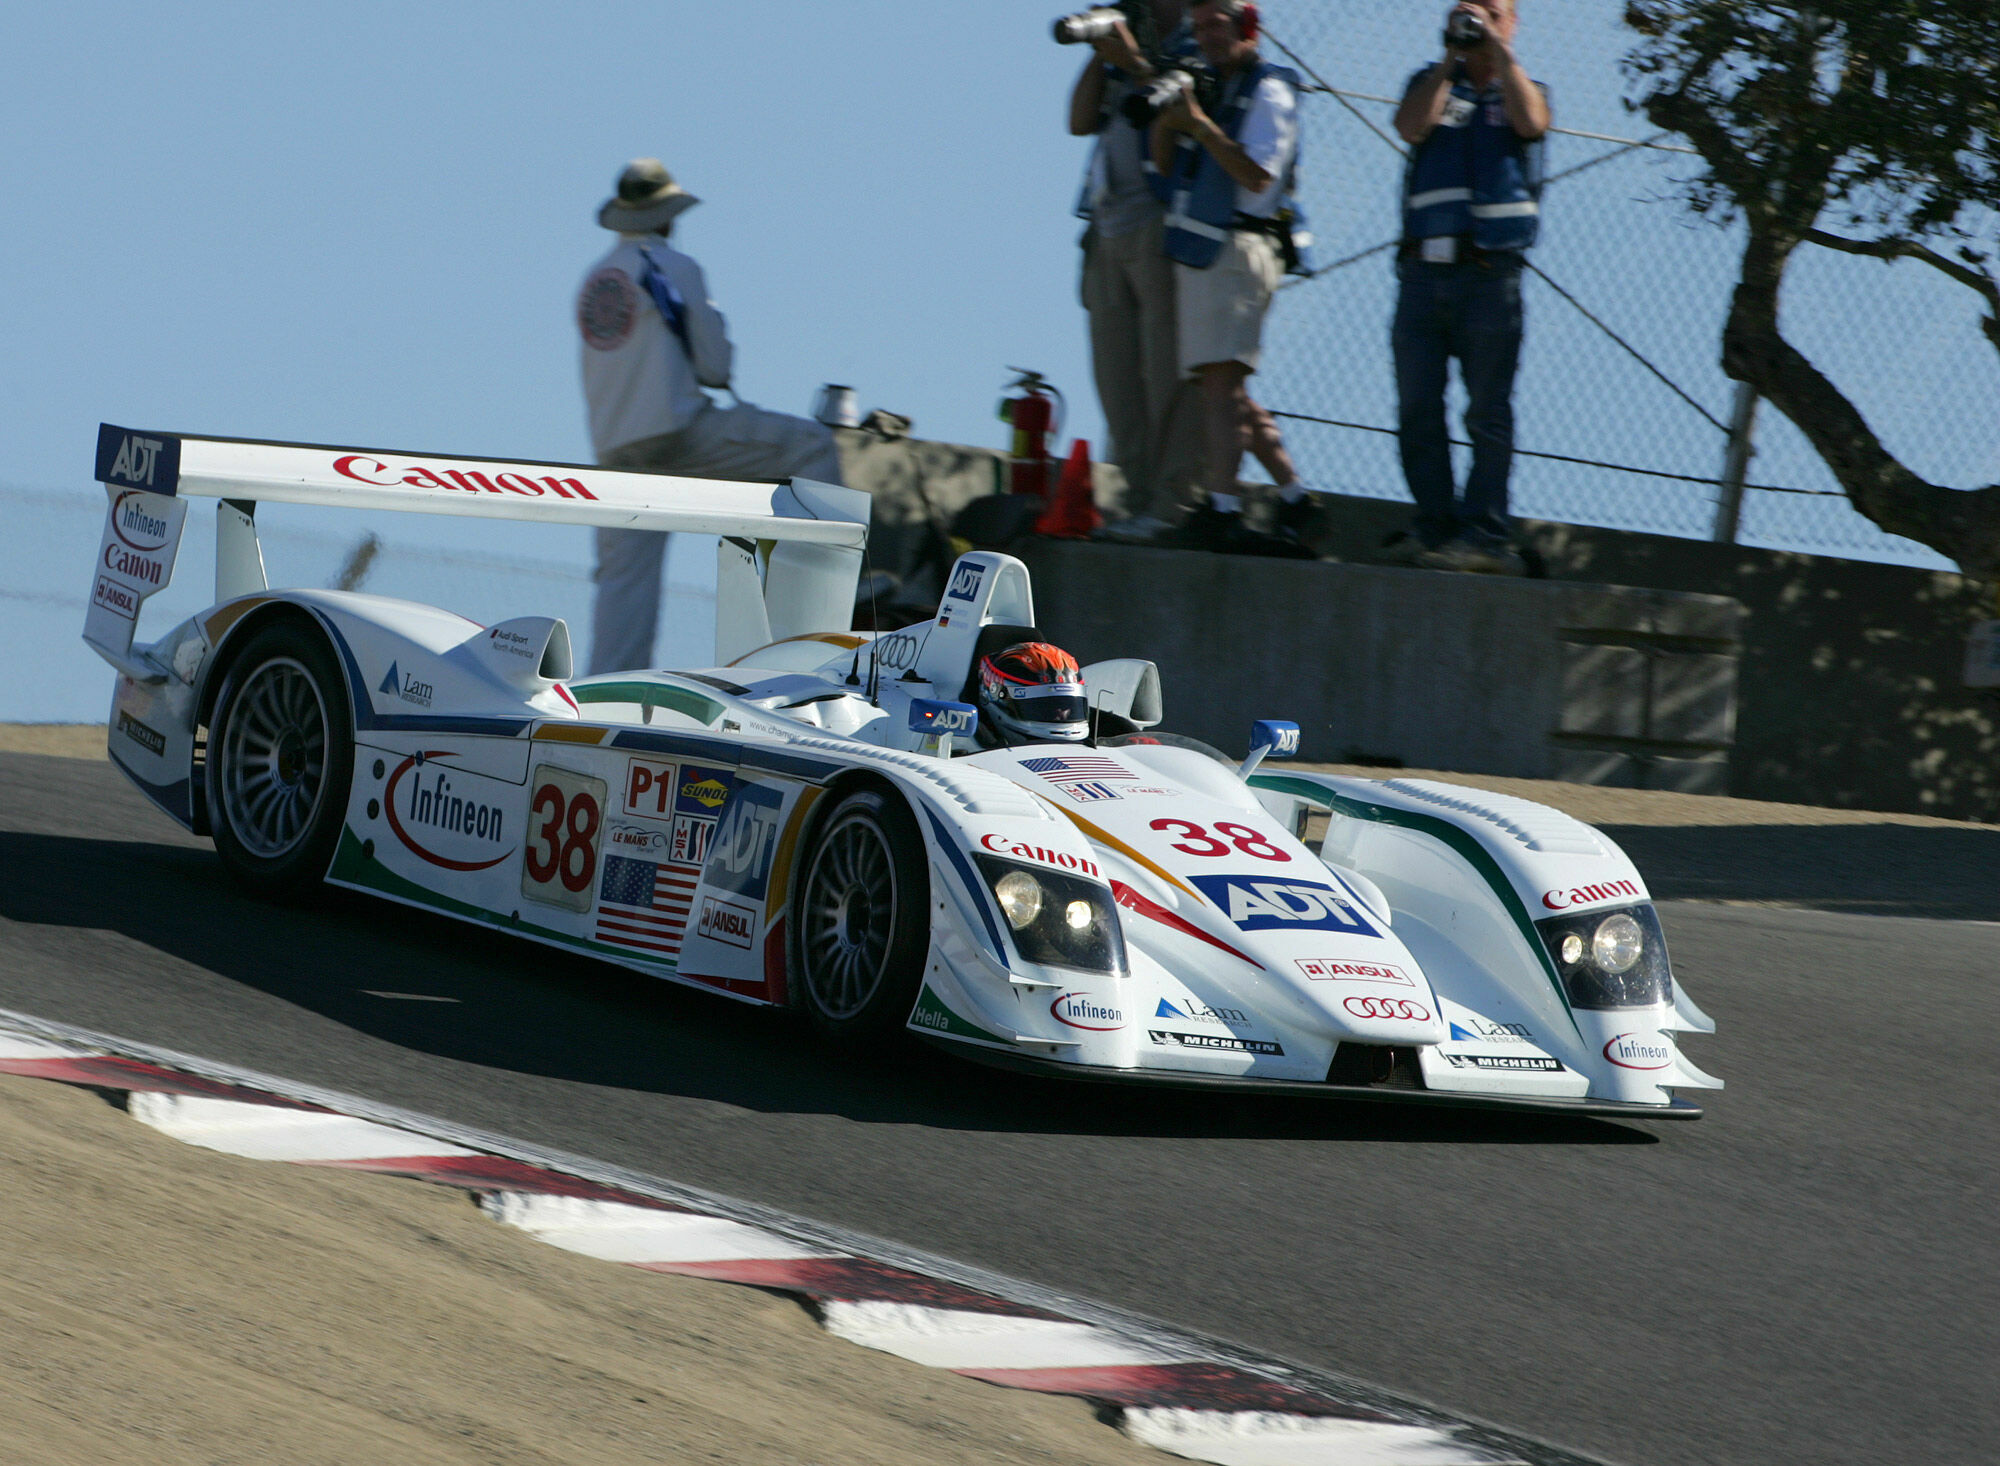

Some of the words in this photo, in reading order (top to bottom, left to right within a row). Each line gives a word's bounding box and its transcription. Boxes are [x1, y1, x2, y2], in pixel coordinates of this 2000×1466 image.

[110, 434, 163, 486] ADT
[332, 455, 600, 501] Canon
[122, 504, 168, 539] Infineon
[104, 543, 163, 586] Canon
[952, 567, 982, 597] ADT
[404, 672, 433, 699] Lam
[932, 710, 973, 731] ADT
[1273, 729, 1300, 751] ADT
[629, 766, 670, 813] P1
[410, 772, 503, 842] Infineon
[526, 784, 600, 892] 38
[612, 832, 623, 843] LE
[624, 833, 649, 847] MANS
[1149, 818, 1292, 862] 38
[981, 833, 1099, 878] Canon
[1542, 879, 1640, 910] Canon
[712, 911, 751, 939] ANSUL
[1331, 963, 1403, 980] ANSUL
[915, 1006, 949, 1030] Hella
[1067, 998, 1123, 1022] Infineon
[1184, 999, 1249, 1022] Lam
[1469, 1018, 1533, 1037] Lam
[1184, 1035, 1276, 1052] MICHELIN
[1617, 1041, 1669, 1061] Infineon
[1477, 1057, 1558, 1070] MICHELIN
